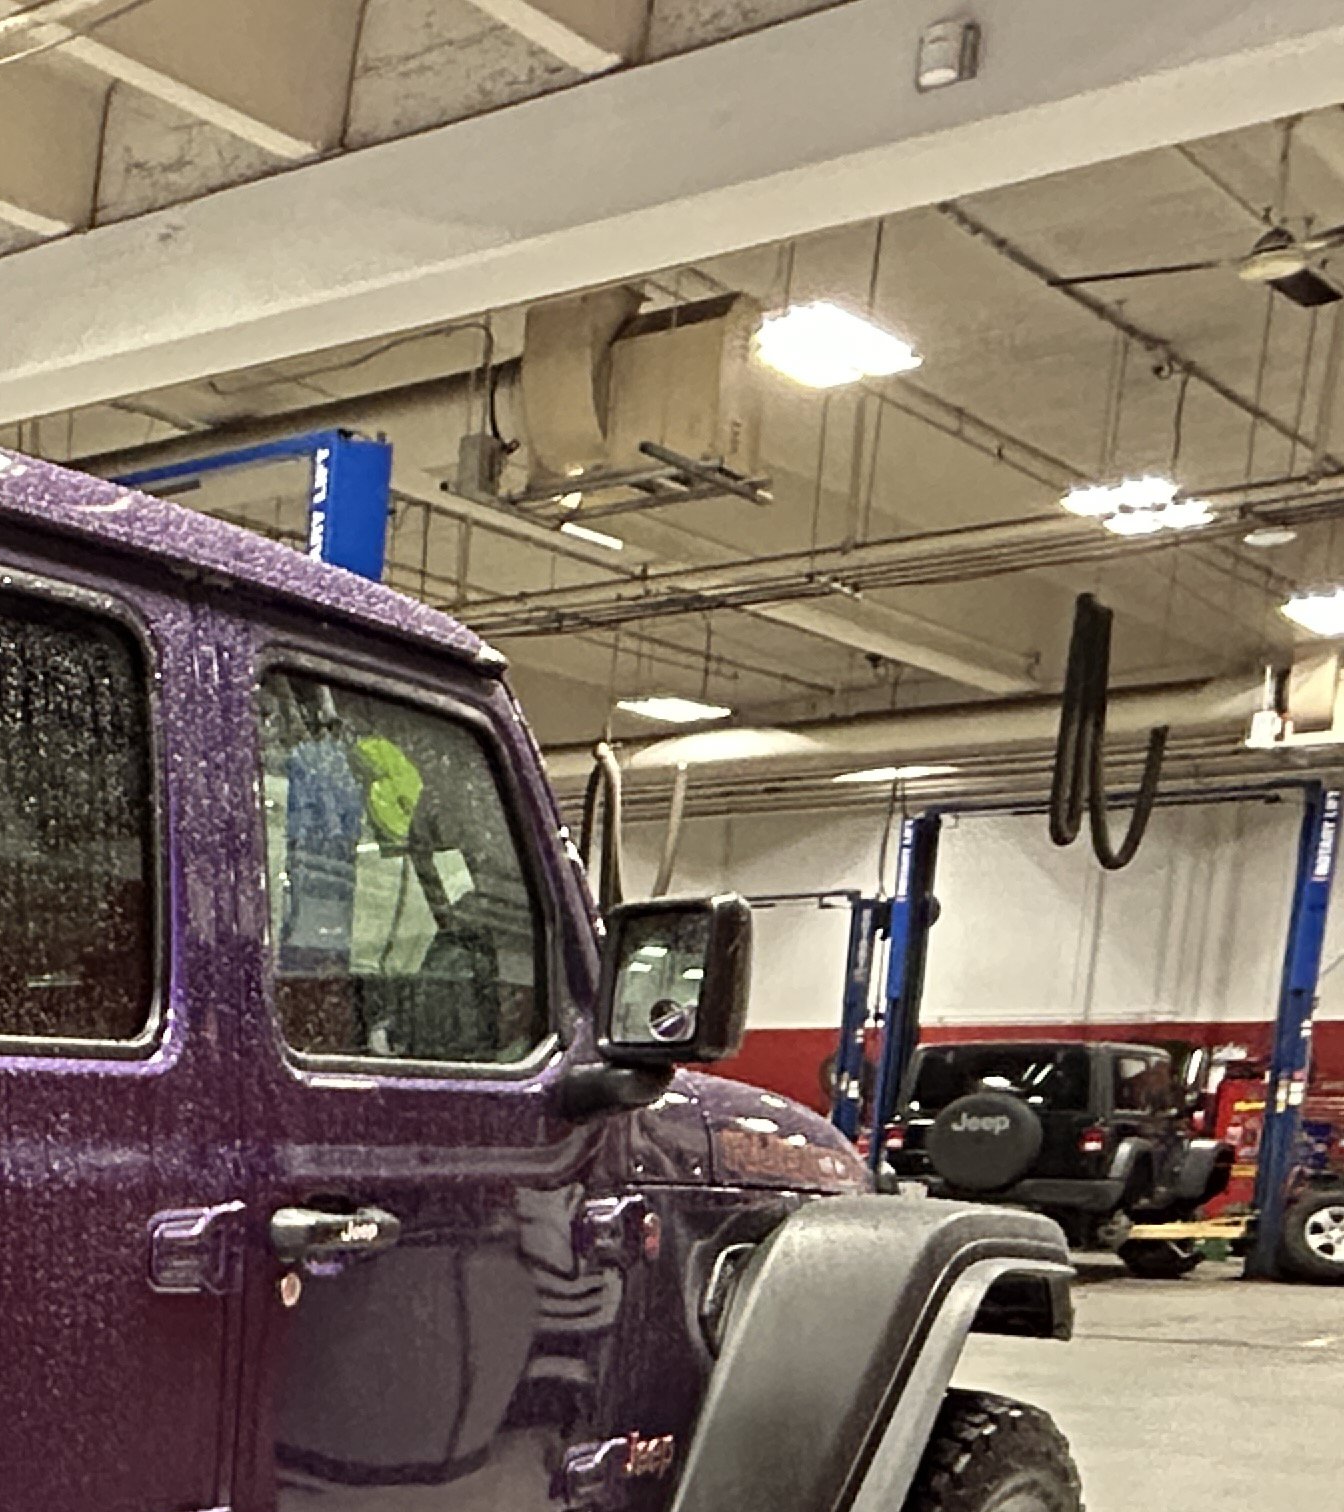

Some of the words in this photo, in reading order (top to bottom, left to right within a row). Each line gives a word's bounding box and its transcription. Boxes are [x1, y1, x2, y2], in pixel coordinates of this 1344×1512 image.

[951, 1112, 1010, 1135] Jeep
[340, 1220, 378, 1241] Jeep
[625, 1431, 674, 1478] Jeep
